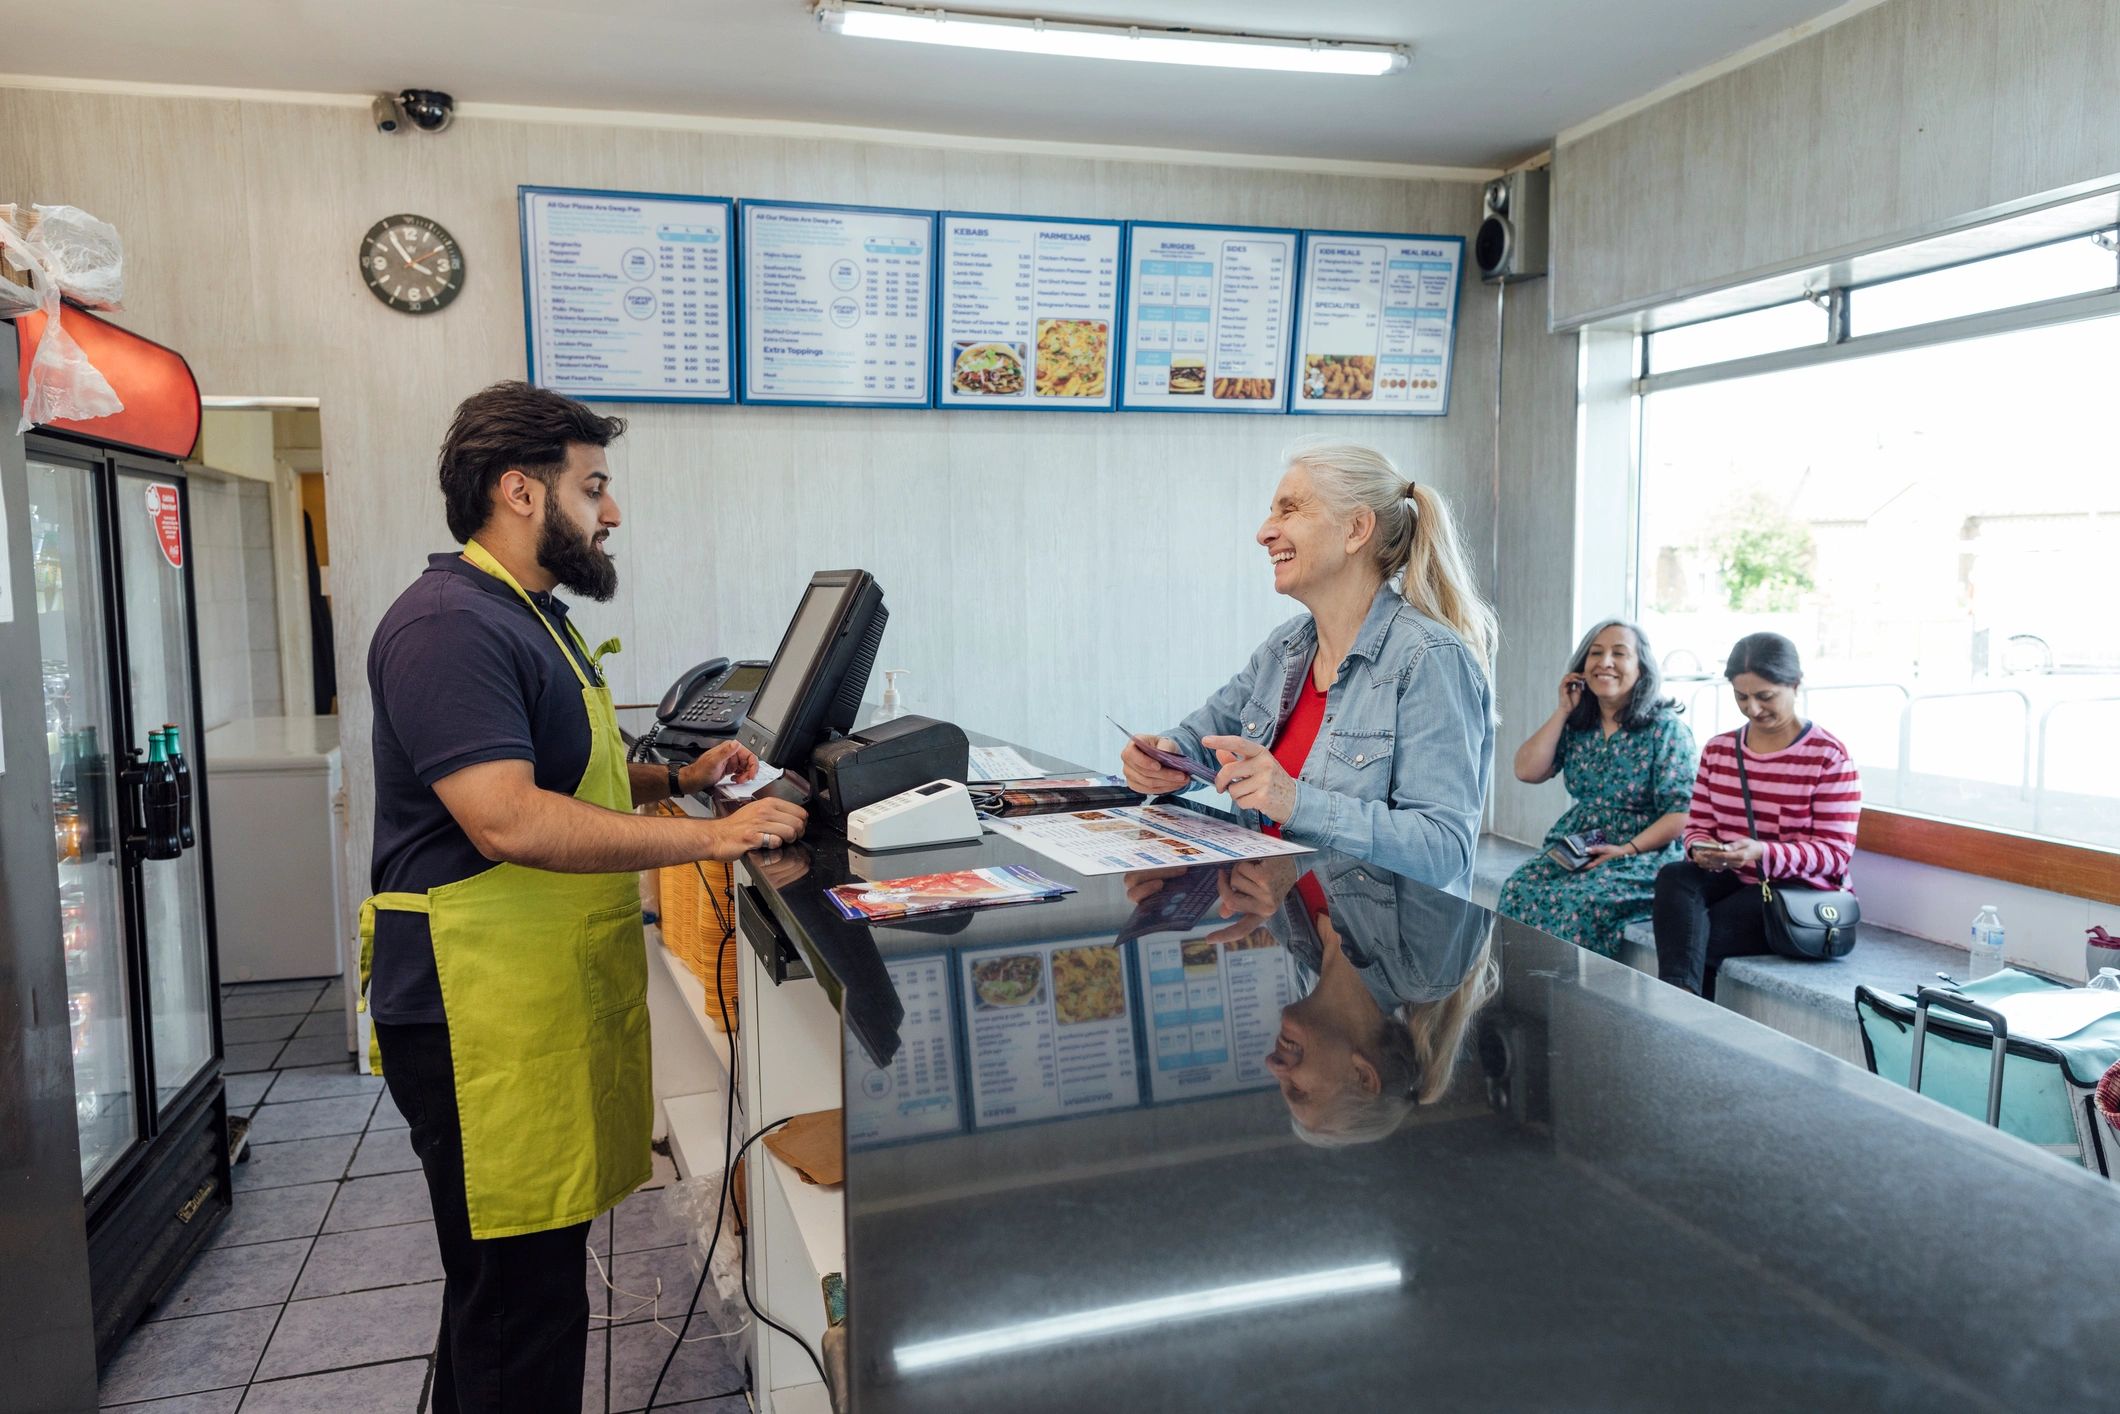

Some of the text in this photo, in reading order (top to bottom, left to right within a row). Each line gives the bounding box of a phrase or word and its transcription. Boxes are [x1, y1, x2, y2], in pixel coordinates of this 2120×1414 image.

[403, 228, 418, 241] 12
[954, 228, 989, 236] KEBABS
[1040, 232, 1091, 241] PARMESANS
[1161, 242, 1195, 250] BURGERS
[373, 256, 387, 271] 9
[437, 259, 450, 272] 3
[408, 288, 421, 301] 6
[788, 347, 823, 356] Toppings
